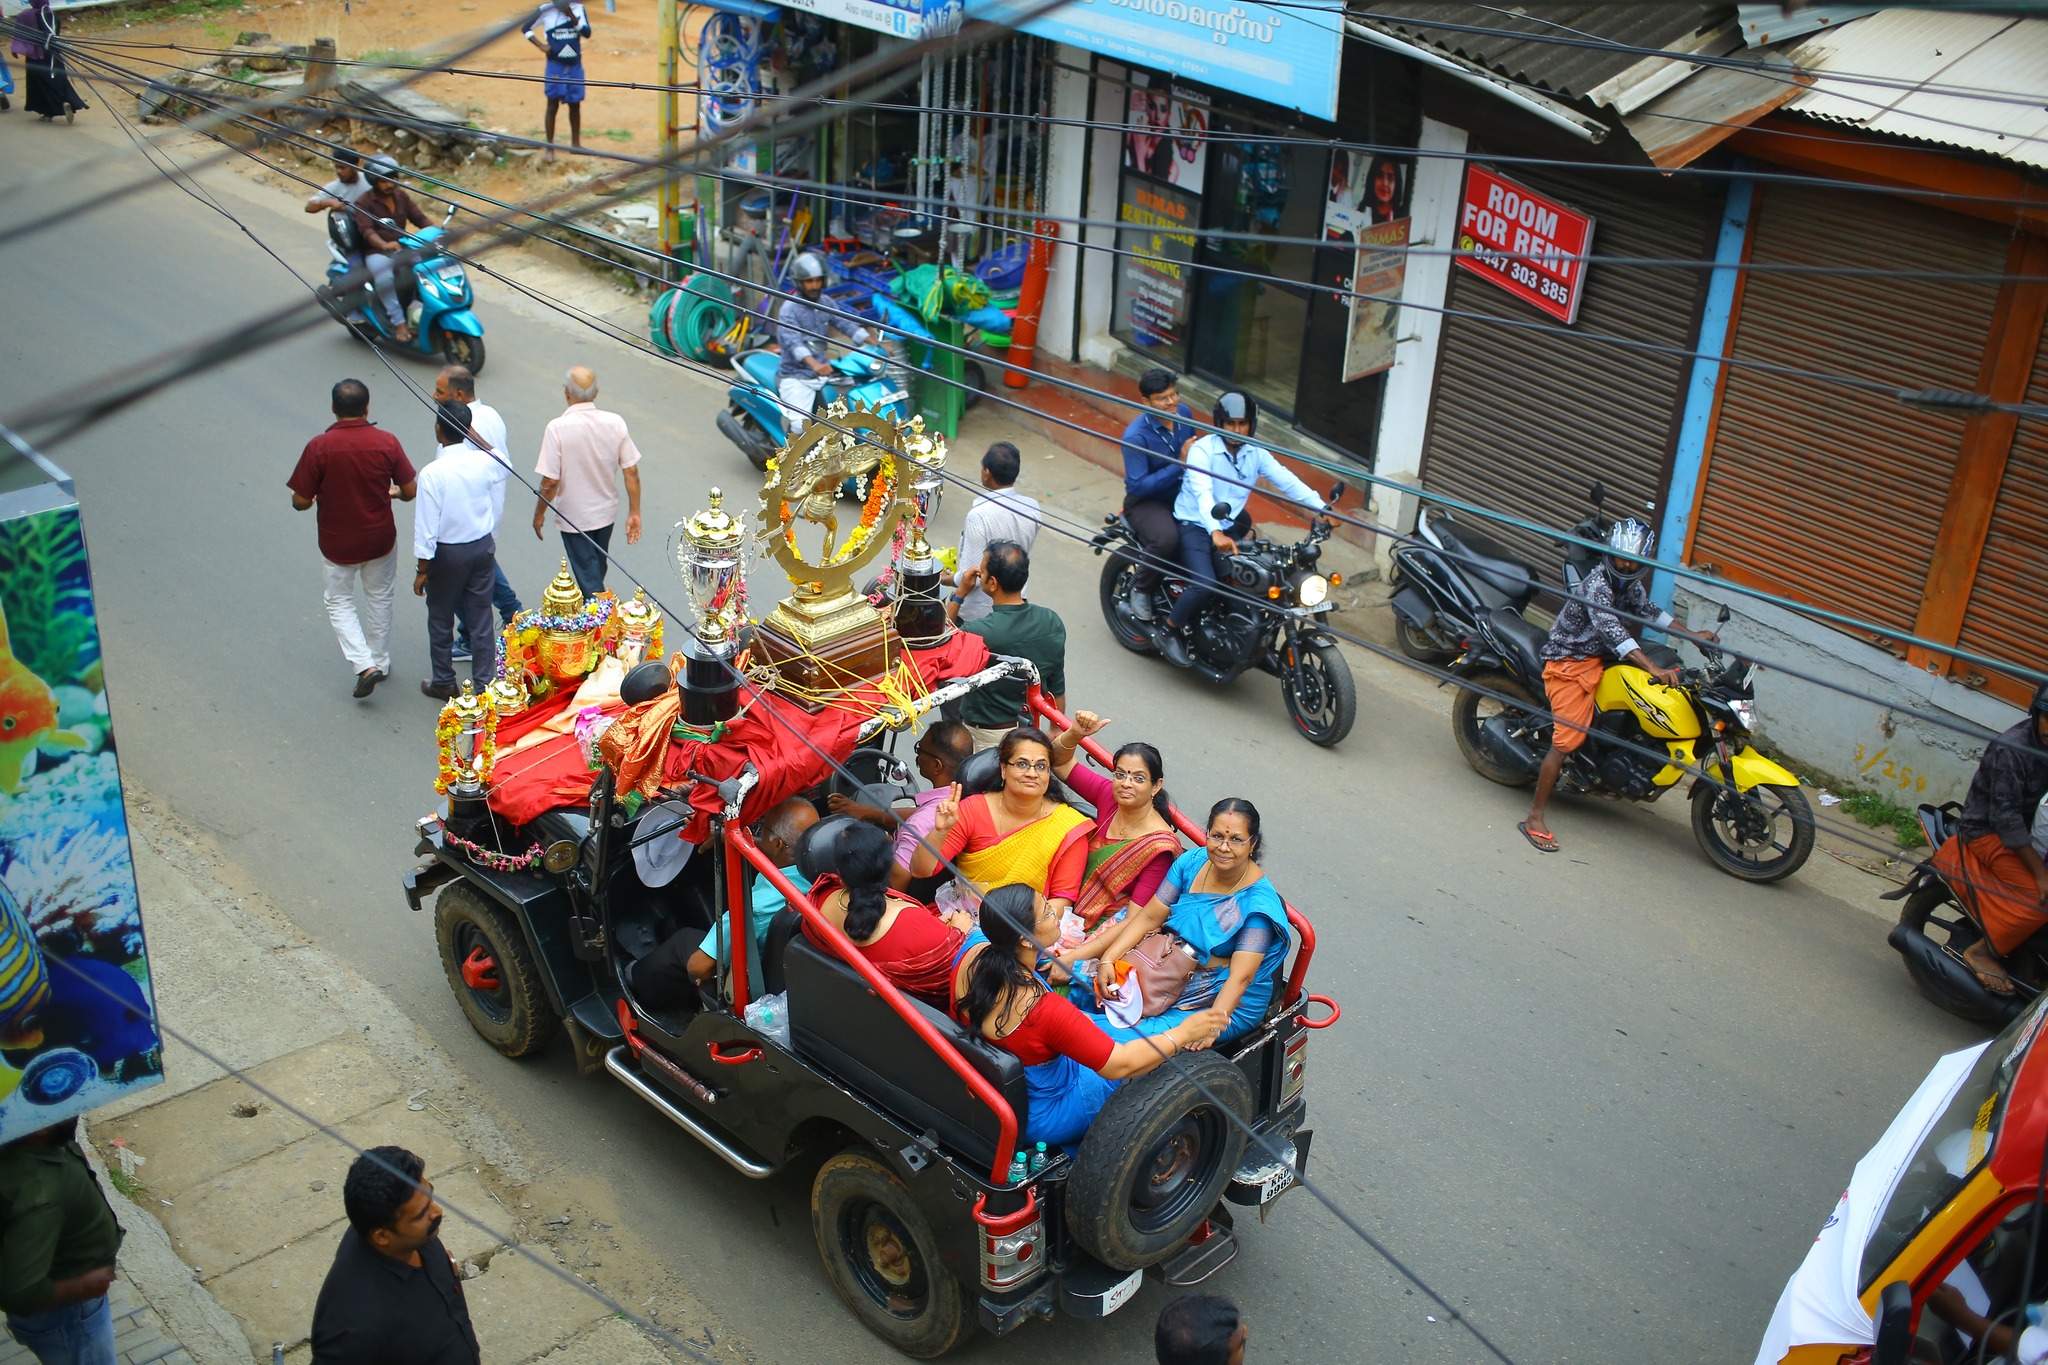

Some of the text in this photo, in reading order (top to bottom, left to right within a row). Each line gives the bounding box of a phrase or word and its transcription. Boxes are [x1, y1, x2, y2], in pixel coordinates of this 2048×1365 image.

[1463, 202, 1577, 279] FOR RENT
[1487, 183, 1559, 240] ROOM
[1474, 243, 1569, 305] 9447 303 385
[1852, 743, 1927, 793] 3/250
